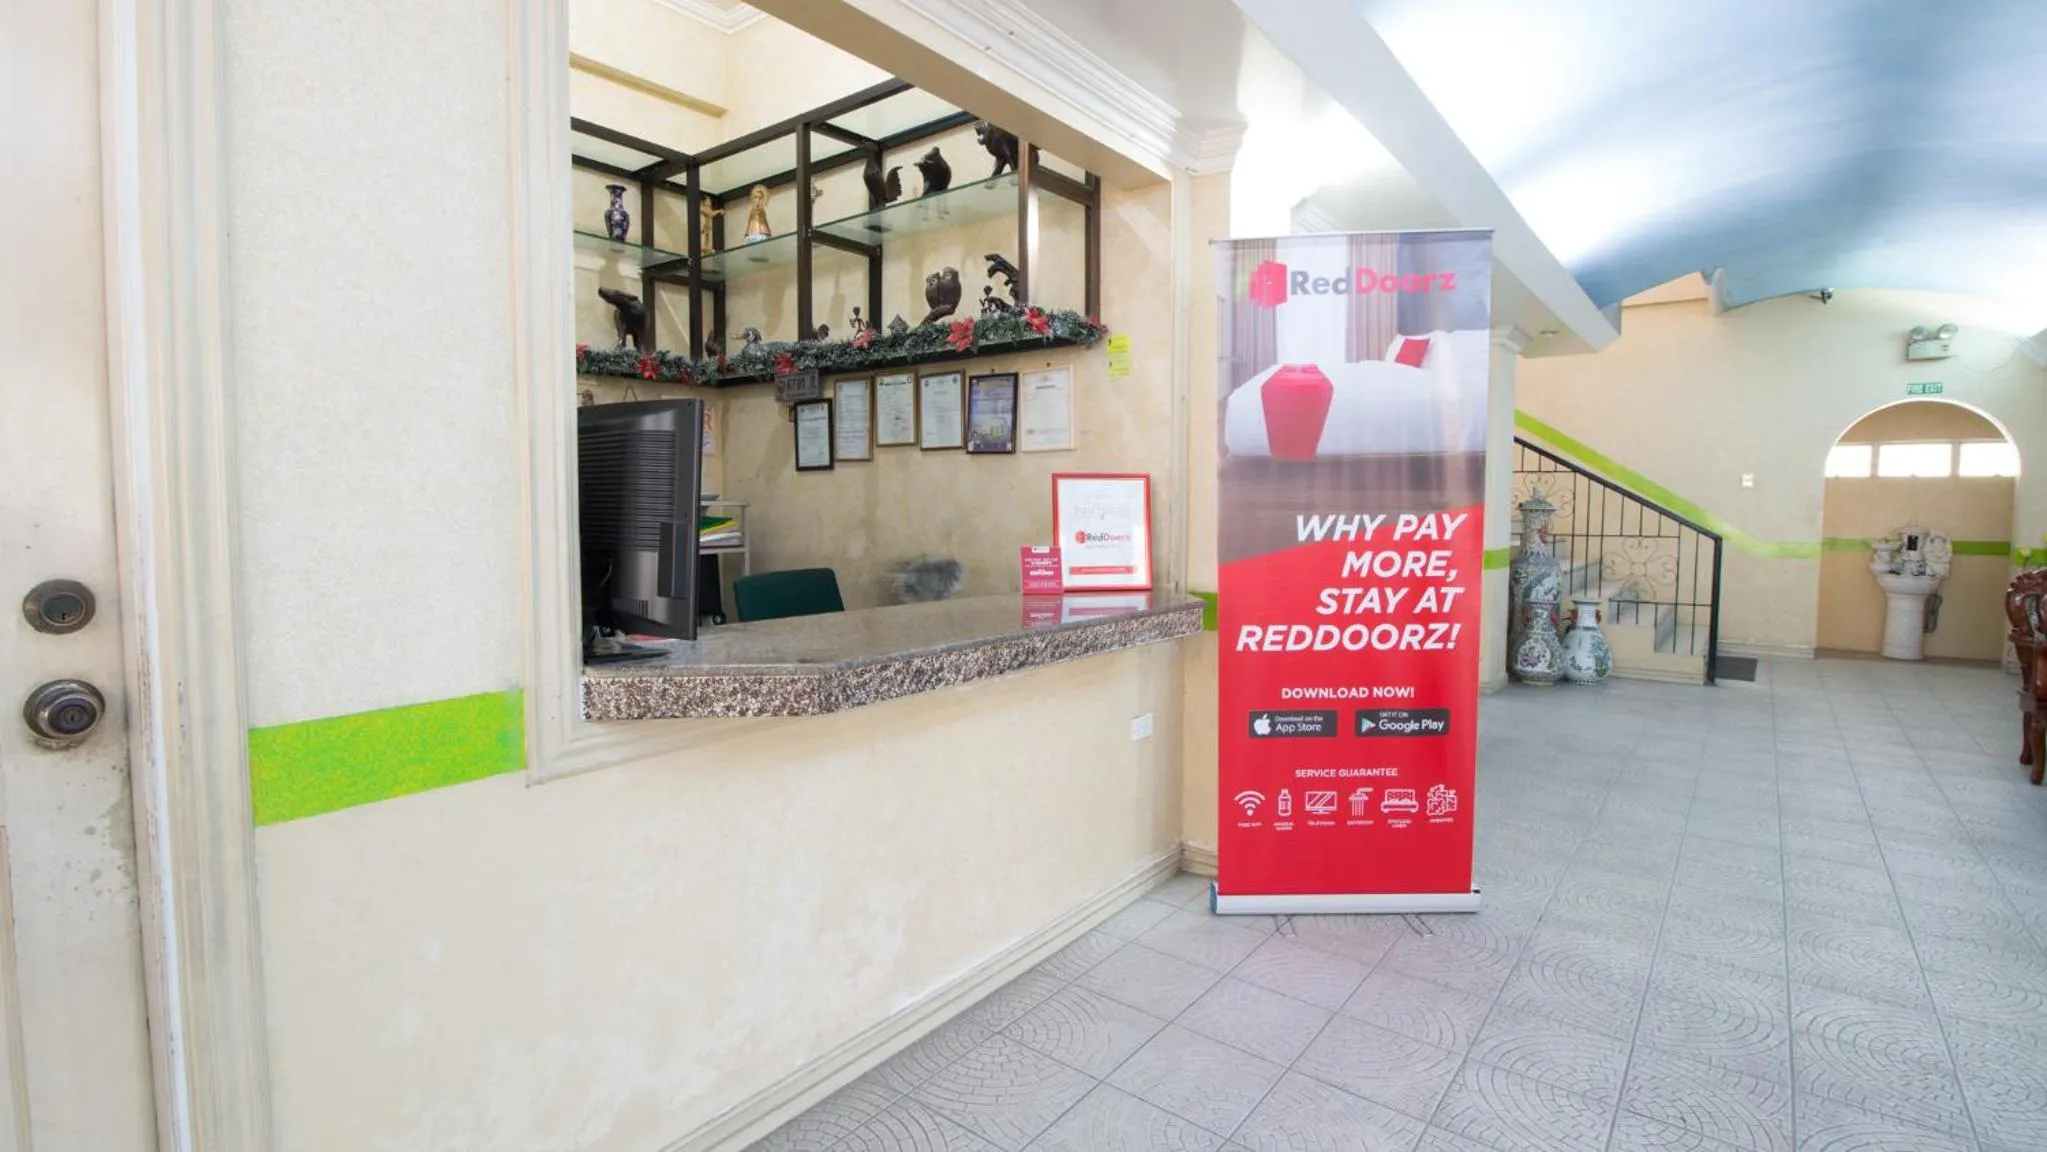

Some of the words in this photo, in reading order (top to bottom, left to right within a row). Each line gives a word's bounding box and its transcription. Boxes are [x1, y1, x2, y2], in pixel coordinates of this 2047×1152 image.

[1290, 267, 1457, 296] RedDoorz
[1296, 514, 1387, 542] WHY
[1393, 513, 1468, 541] PAY
[1341, 550, 1458, 582] MORE,
[1315, 587, 1409, 615] STAY
[1413, 586, 1465, 614] AT
[1236, 623, 1461, 651] REDDOORZ!
[1281, 687, 1369, 699] DOWNLOAD
[1372, 686, 1415, 698] NOW!
[1275, 723, 1295, 734] App
[1297, 722, 1322, 732] Store
[1379, 719, 1420, 733] Google
[1421, 719, 1444, 732] Play
[1295, 768, 1336, 778] SERVICE
[1338, 767, 1398, 777] GUARANTEE
